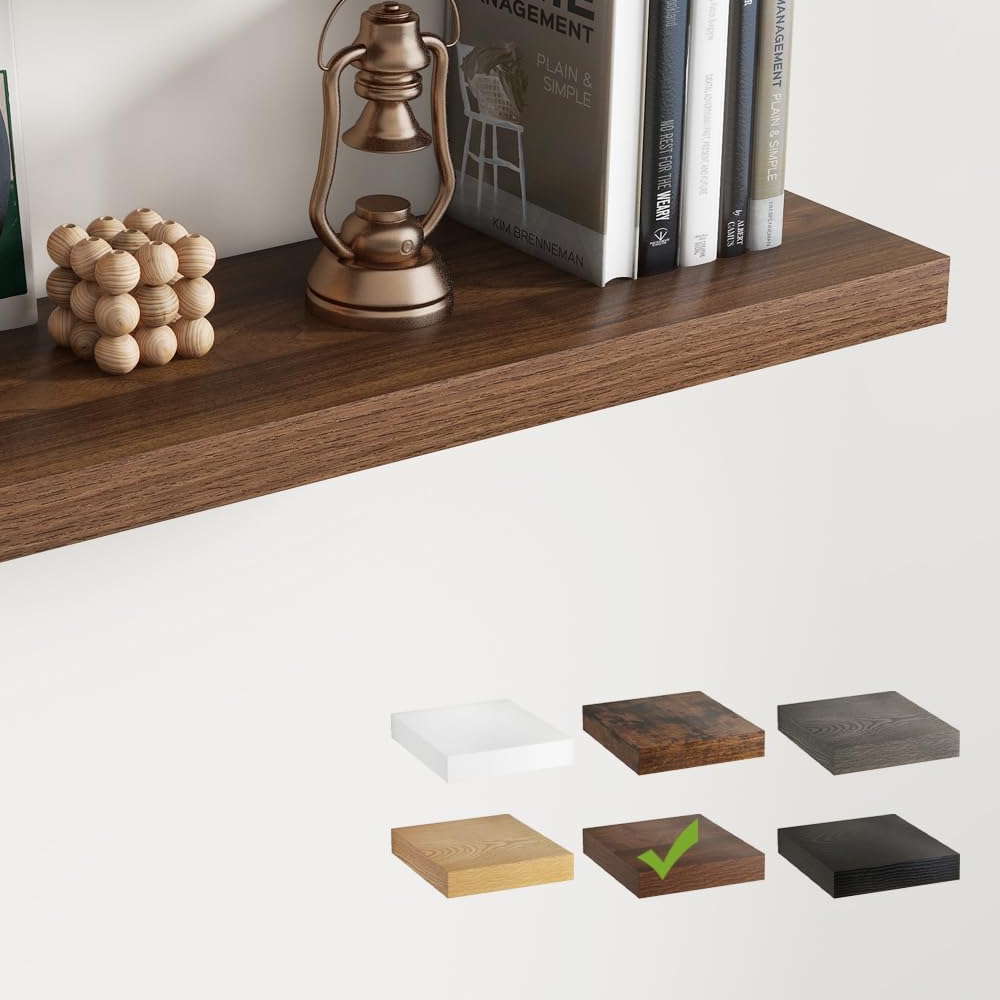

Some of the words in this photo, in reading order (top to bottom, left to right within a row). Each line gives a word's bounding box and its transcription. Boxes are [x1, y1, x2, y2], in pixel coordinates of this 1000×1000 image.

[536, 53, 578, 83] PLAIN
[583, 72, 592, 88] &
[543, 77, 592, 109] SIMPLE
[770, 94, 782, 128] PLAIN
[660, 119, 674, 132] NO
[770, 130, 780, 138] &
[659, 133, 673, 153] REST
[658, 154, 673, 173] FOR
[767, 140, 779, 182] SIMPLE
[657, 173, 672, 190] THE
[655, 190, 671, 221] WEARY
[492, 217, 511, 233] KIM
[513, 226, 584, 268] BRENNEMAN
[726, 221, 736, 247] CAMUS
[736, 220, 745, 245] ALBERT
